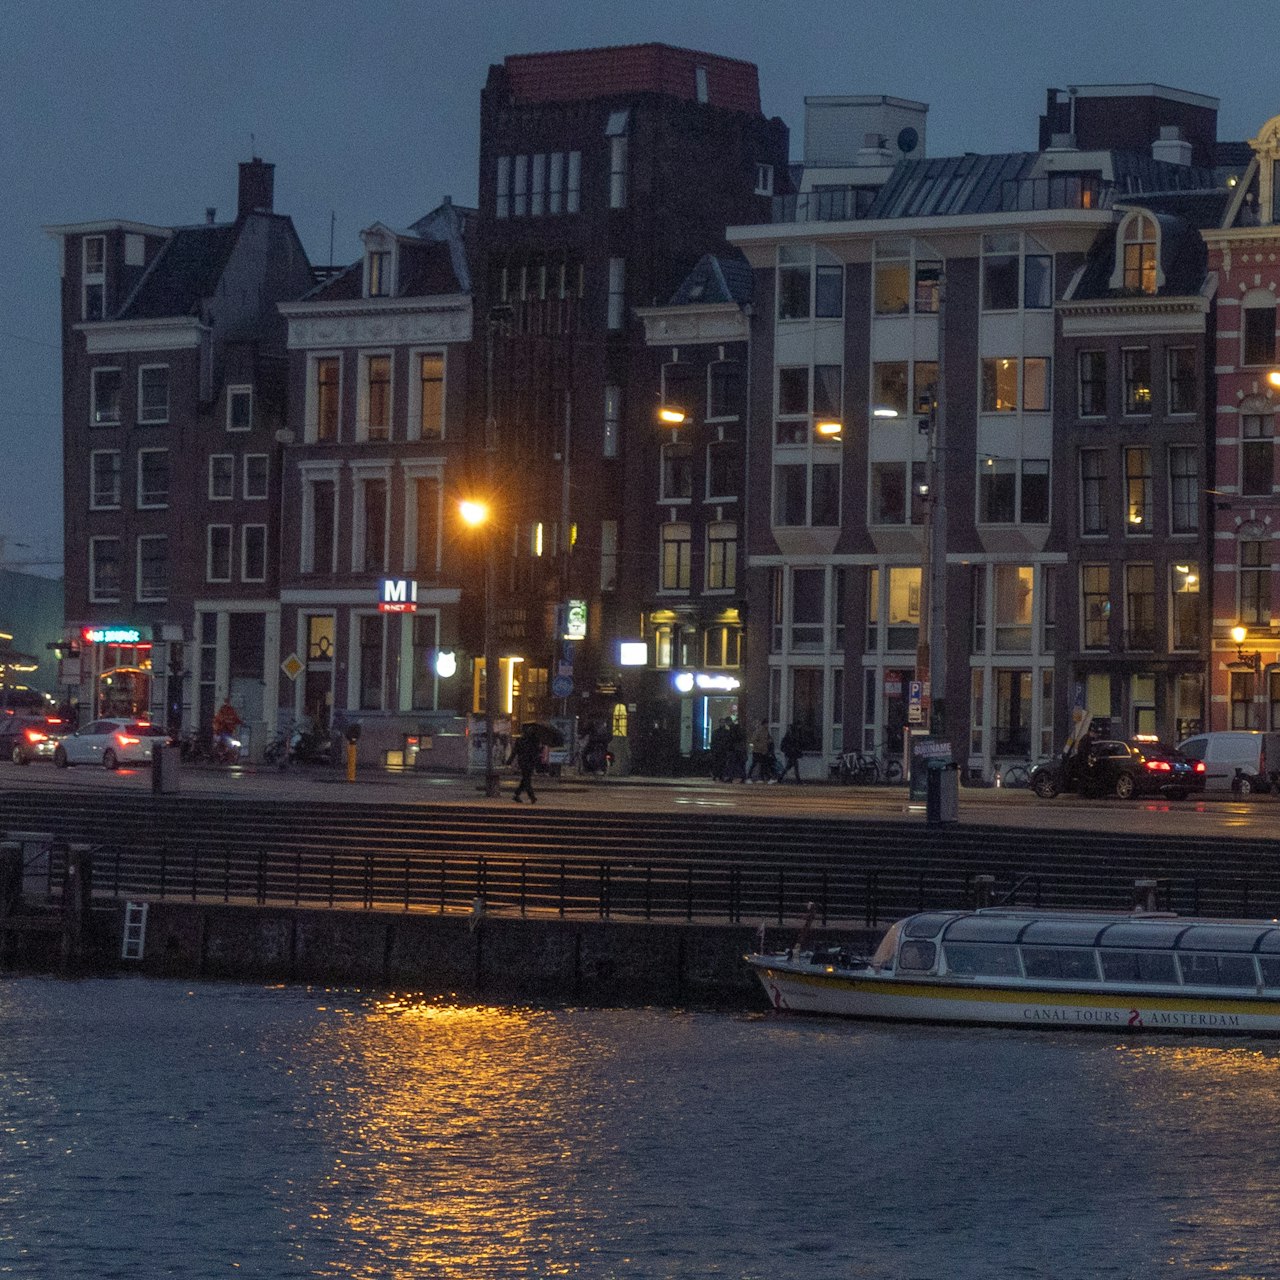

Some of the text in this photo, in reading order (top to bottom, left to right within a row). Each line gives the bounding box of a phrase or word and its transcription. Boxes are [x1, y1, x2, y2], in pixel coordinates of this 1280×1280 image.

[911, 683, 919, 697] P
[1023, 1008, 1240, 1026] CANAL TOURS AMSTERDAM
